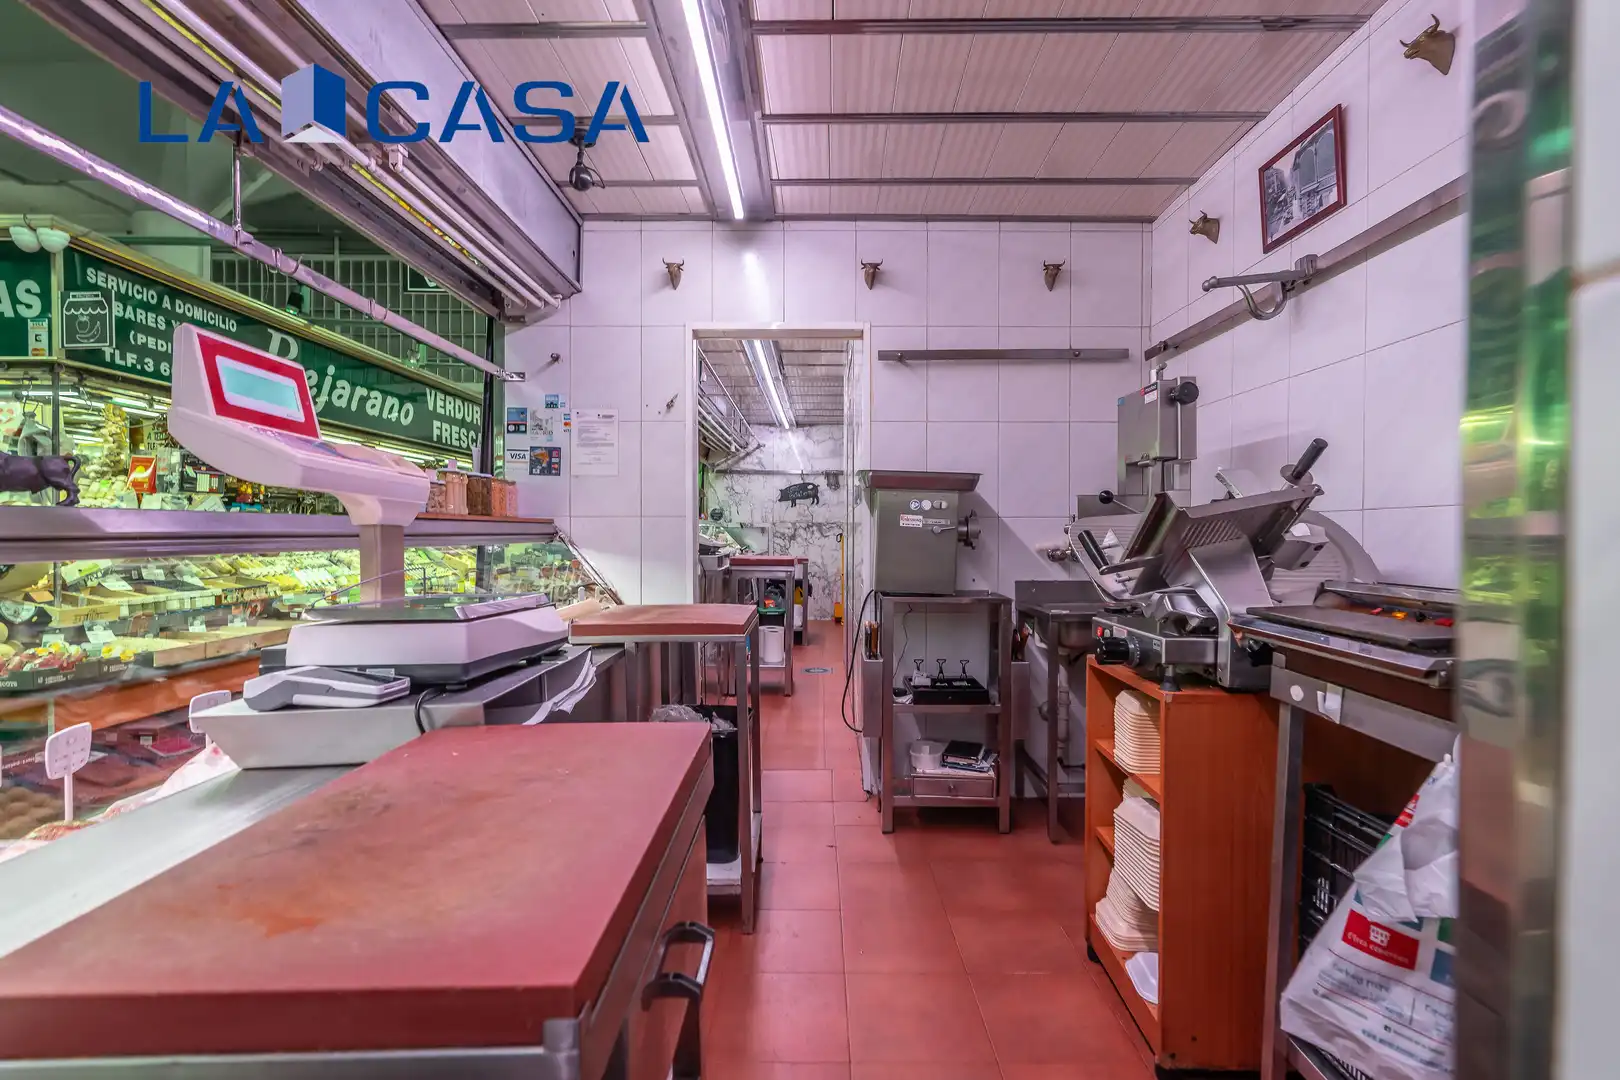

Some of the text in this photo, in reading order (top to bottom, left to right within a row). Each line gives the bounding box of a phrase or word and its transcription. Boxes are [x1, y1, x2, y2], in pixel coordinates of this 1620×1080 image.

[86, 267, 237, 333] SERVICIO A DOMICILIO
[114, 301, 166, 331] BARES
[425, 387, 481, 425] VERDUR
[510, 452, 527, 460] VISA
